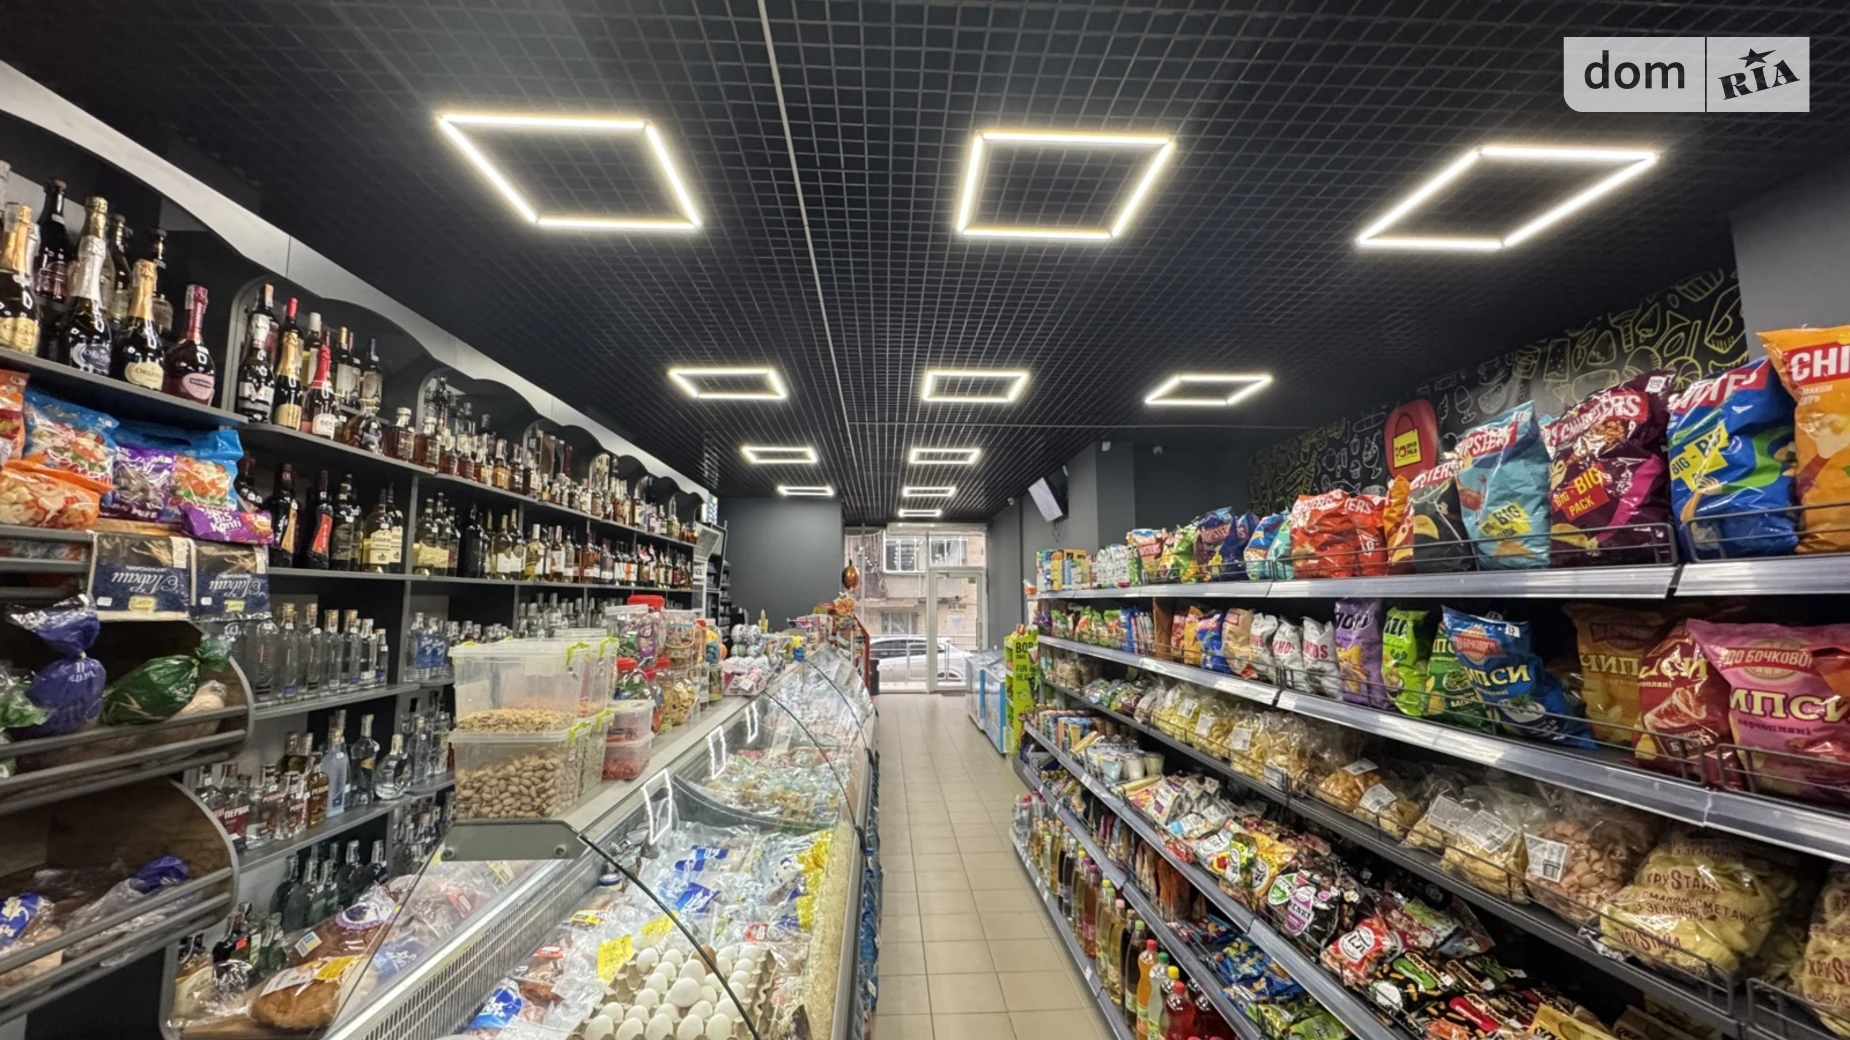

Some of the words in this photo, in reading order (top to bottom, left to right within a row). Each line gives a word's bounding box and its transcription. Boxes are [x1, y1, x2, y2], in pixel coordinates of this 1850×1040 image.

[1575, 466, 1603, 495] BIG
[1569, 496, 1595, 516] PACK
[1725, 650, 1742, 665] ДО
